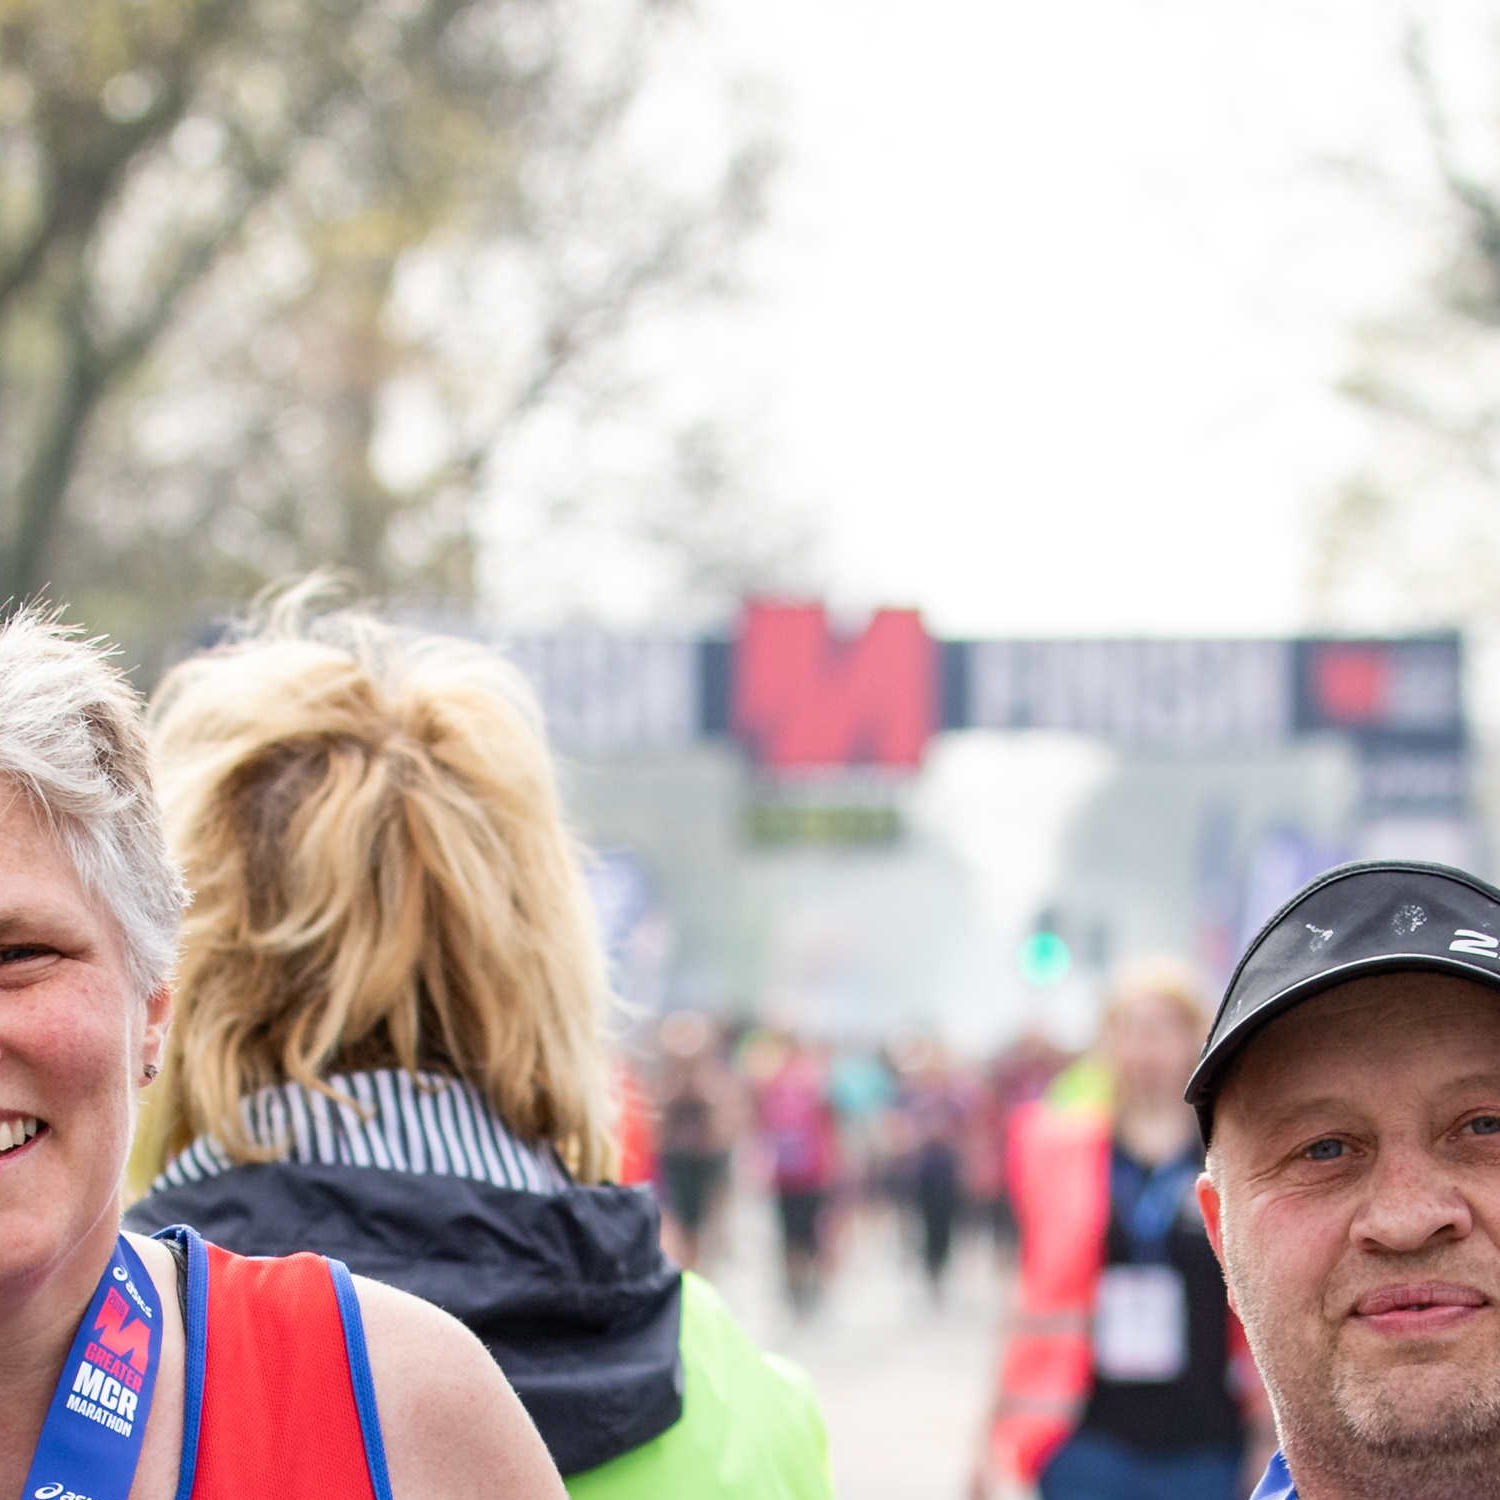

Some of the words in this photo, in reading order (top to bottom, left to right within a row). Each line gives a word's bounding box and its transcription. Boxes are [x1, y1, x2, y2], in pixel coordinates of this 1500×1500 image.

[106, 1290, 128, 1315] 2019
[72, 1360, 139, 1422] MCR
[84, 1342, 143, 1393] GREATER
[66, 1393, 133, 1438] MARATHON
